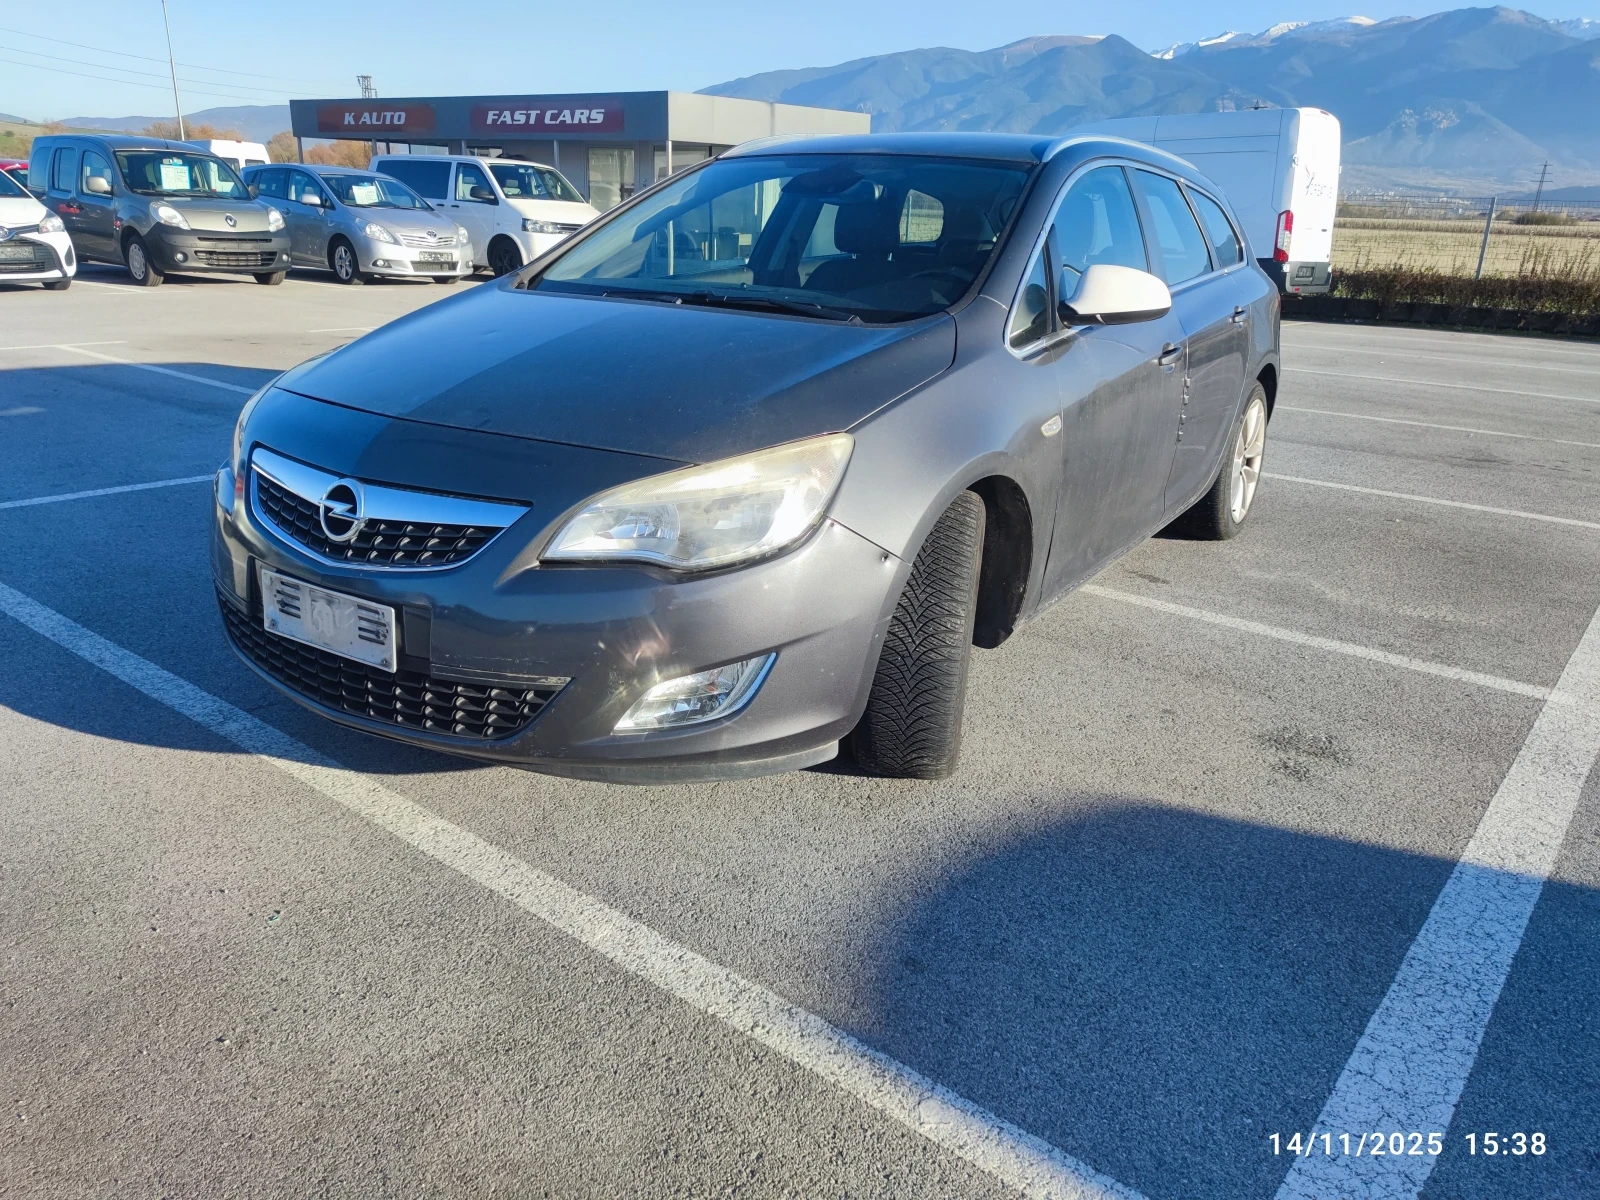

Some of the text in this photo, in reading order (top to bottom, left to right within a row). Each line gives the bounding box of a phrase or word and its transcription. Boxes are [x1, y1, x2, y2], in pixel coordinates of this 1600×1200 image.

[343, 111, 406, 125] K AUTO
[486, 108, 605, 125] FAST CARS
